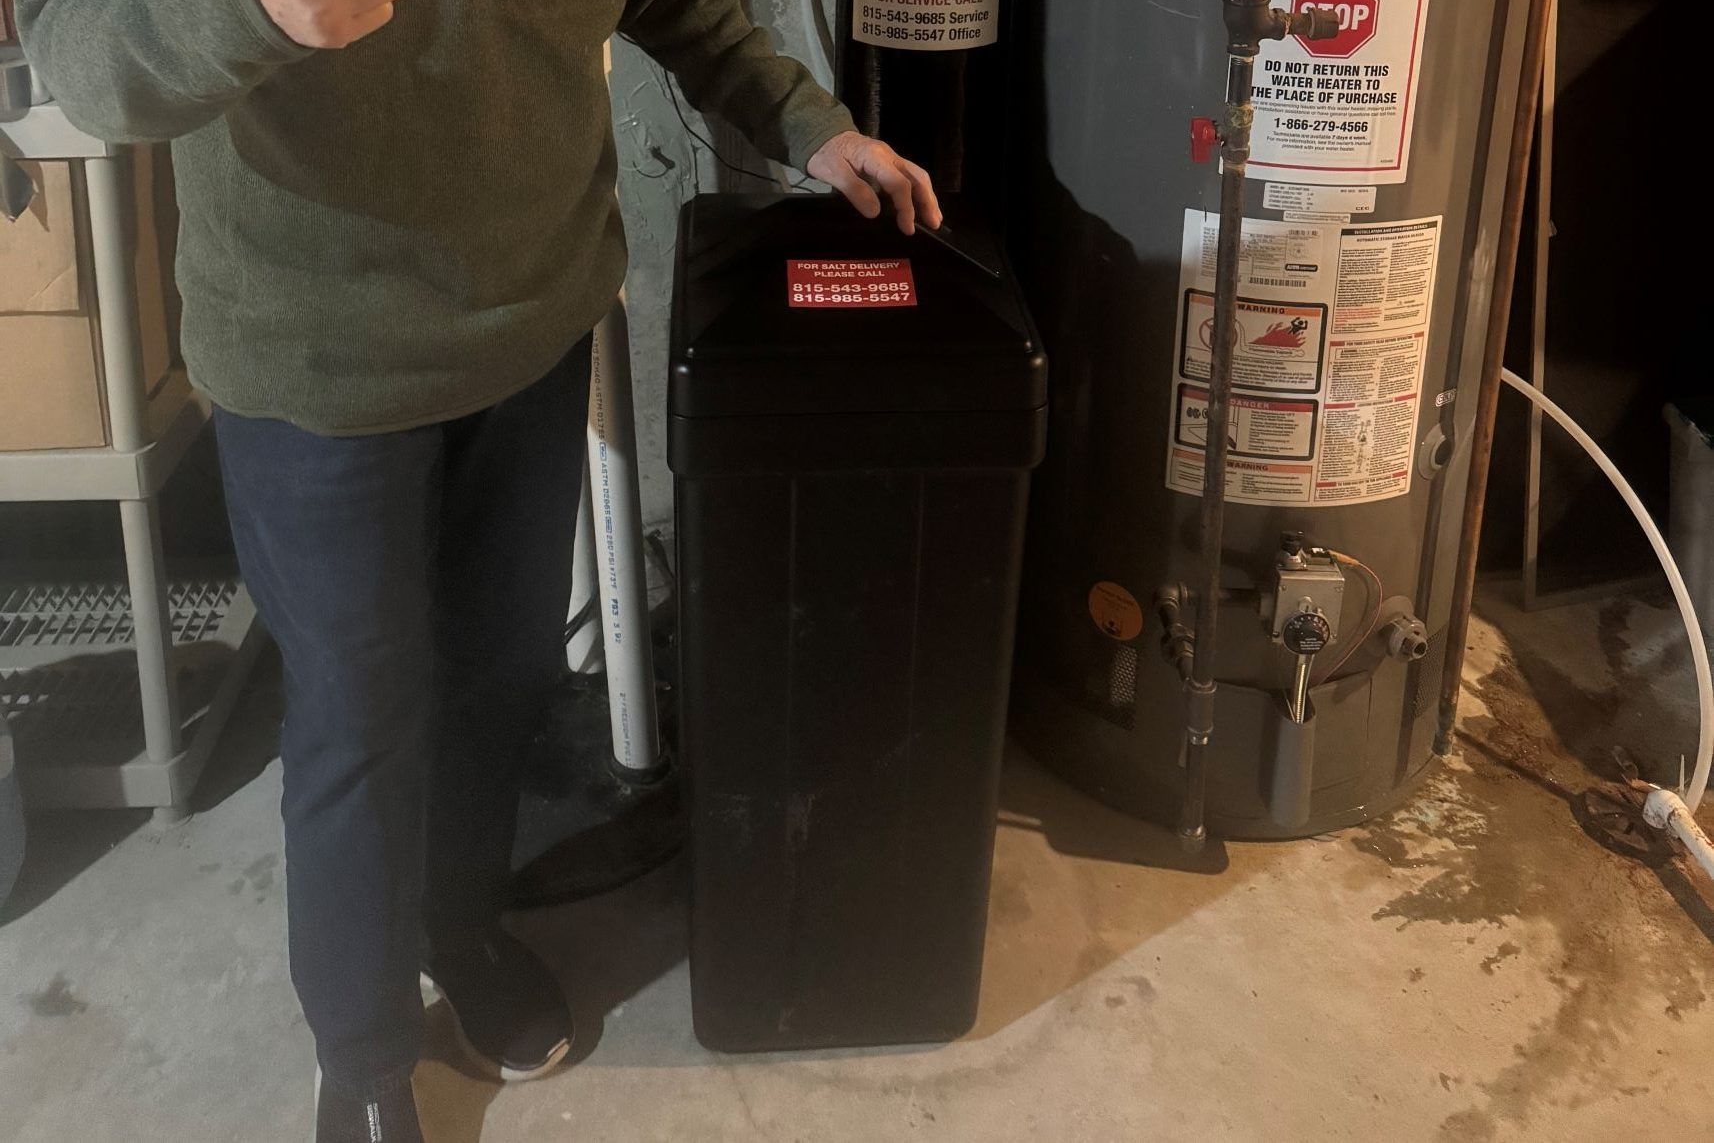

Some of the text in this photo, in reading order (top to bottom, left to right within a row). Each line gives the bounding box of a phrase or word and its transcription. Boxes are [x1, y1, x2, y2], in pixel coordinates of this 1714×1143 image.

[862, 6, 990, 25] 815-543-9685 Service
[862, 22, 981, 41] 815-985-5547 Office
[1265, 60, 1389, 77] DO NOT RETURN THIS
[1271, 75, 1380, 90] WATER HEATER TO
[1250, 86, 1397, 104] THE PLACE OF PURCHASE
[1274, 117, 1369, 133] 1-866-279-4566
[849, 262, 900, 270] DELIVERY
[793, 282, 909, 293] 815-543-9685
[793, 292, 910, 303] 815-985-5547
[1237, 303, 1285, 315] WARNING
[1227, 460, 1269, 471] WARNING
